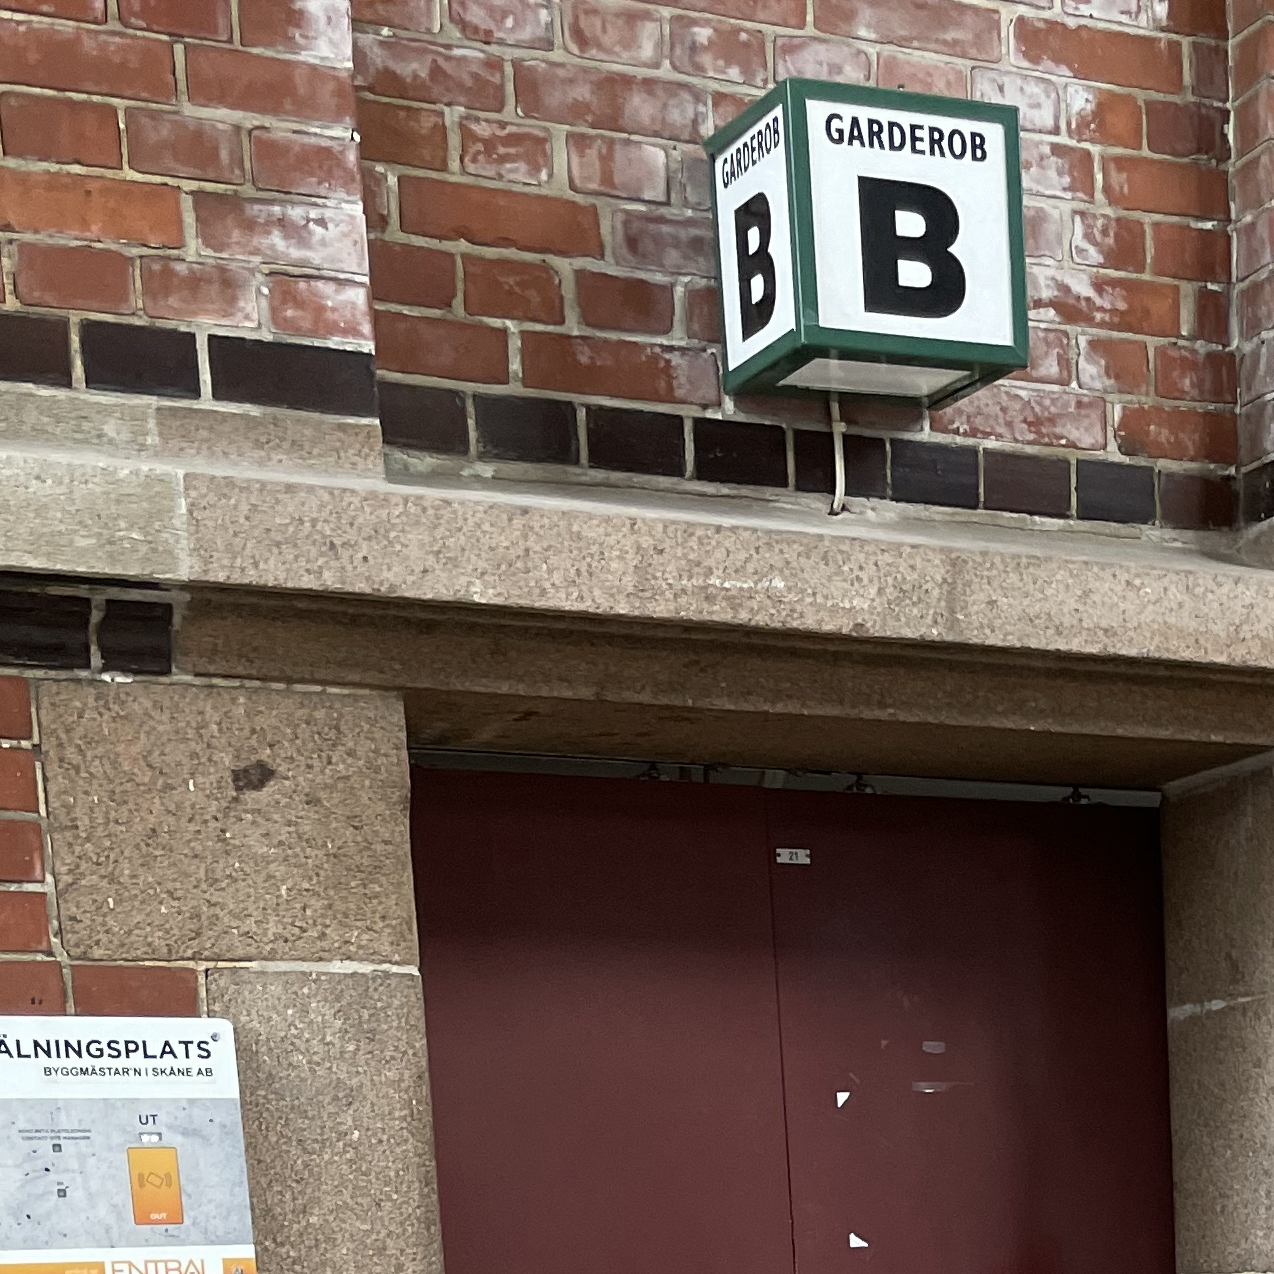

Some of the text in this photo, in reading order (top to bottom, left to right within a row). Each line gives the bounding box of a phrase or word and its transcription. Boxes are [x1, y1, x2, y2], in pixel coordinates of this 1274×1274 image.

[721, 115, 780, 190] GARDEROB
[825, 113, 988, 162] GARDEROB
[733, 191, 776, 342] B
[857, 175, 966, 318] B
[788, 851, 799, 862] 21
[144, 1067, 148, 1077] I
[151, 1066, 193, 1077] SKÅNE
[196, 1067, 213, 1077] AB
[138, 1113, 158, 1125] UT
